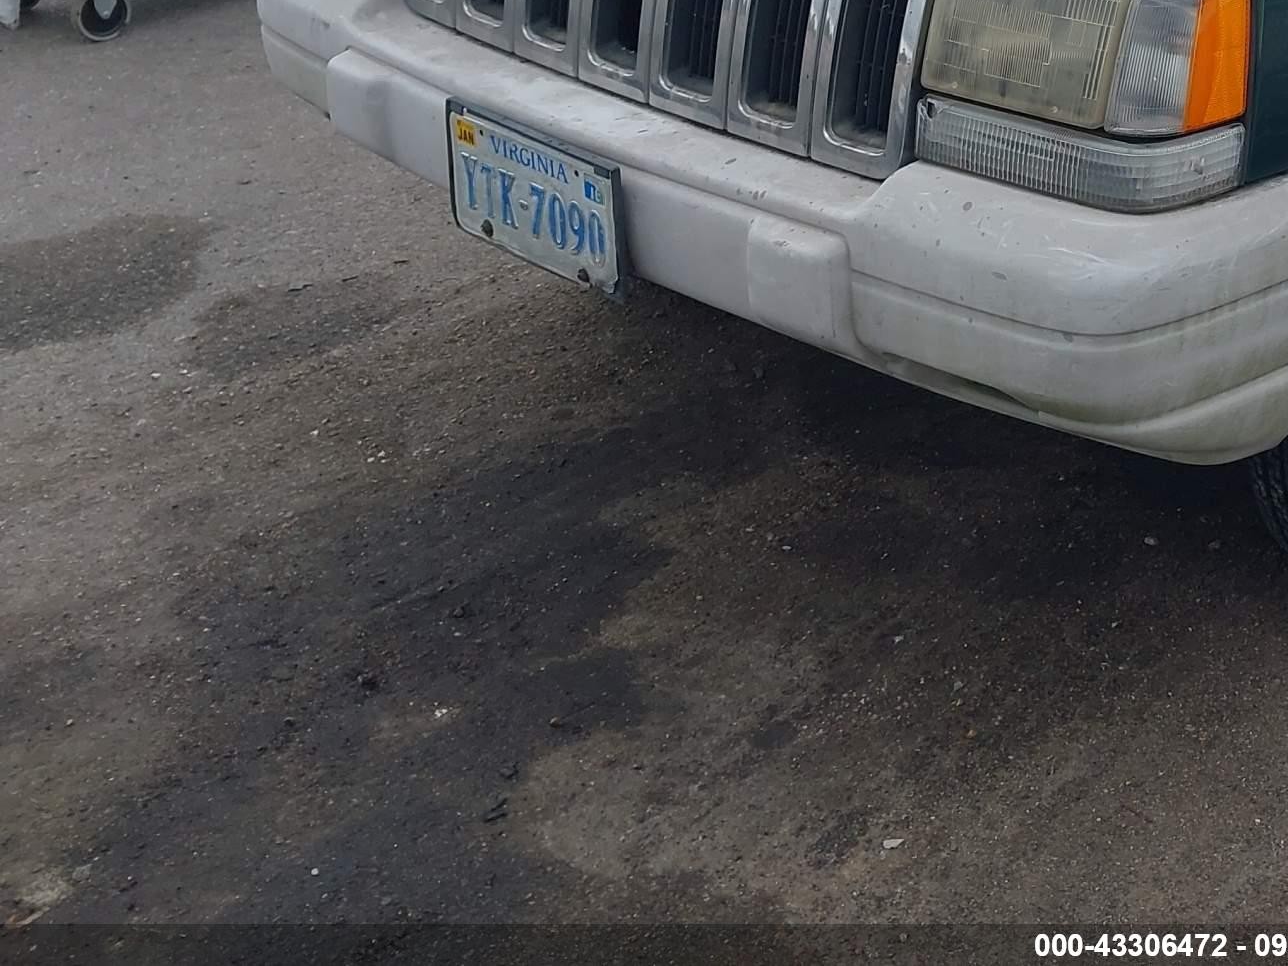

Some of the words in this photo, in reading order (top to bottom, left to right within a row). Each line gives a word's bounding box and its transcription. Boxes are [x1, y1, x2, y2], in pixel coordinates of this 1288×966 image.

[457, 127, 475, 145] JAN
[490, 135, 569, 184] VIRGINIA
[460, 151, 606, 268] YTK-7090
